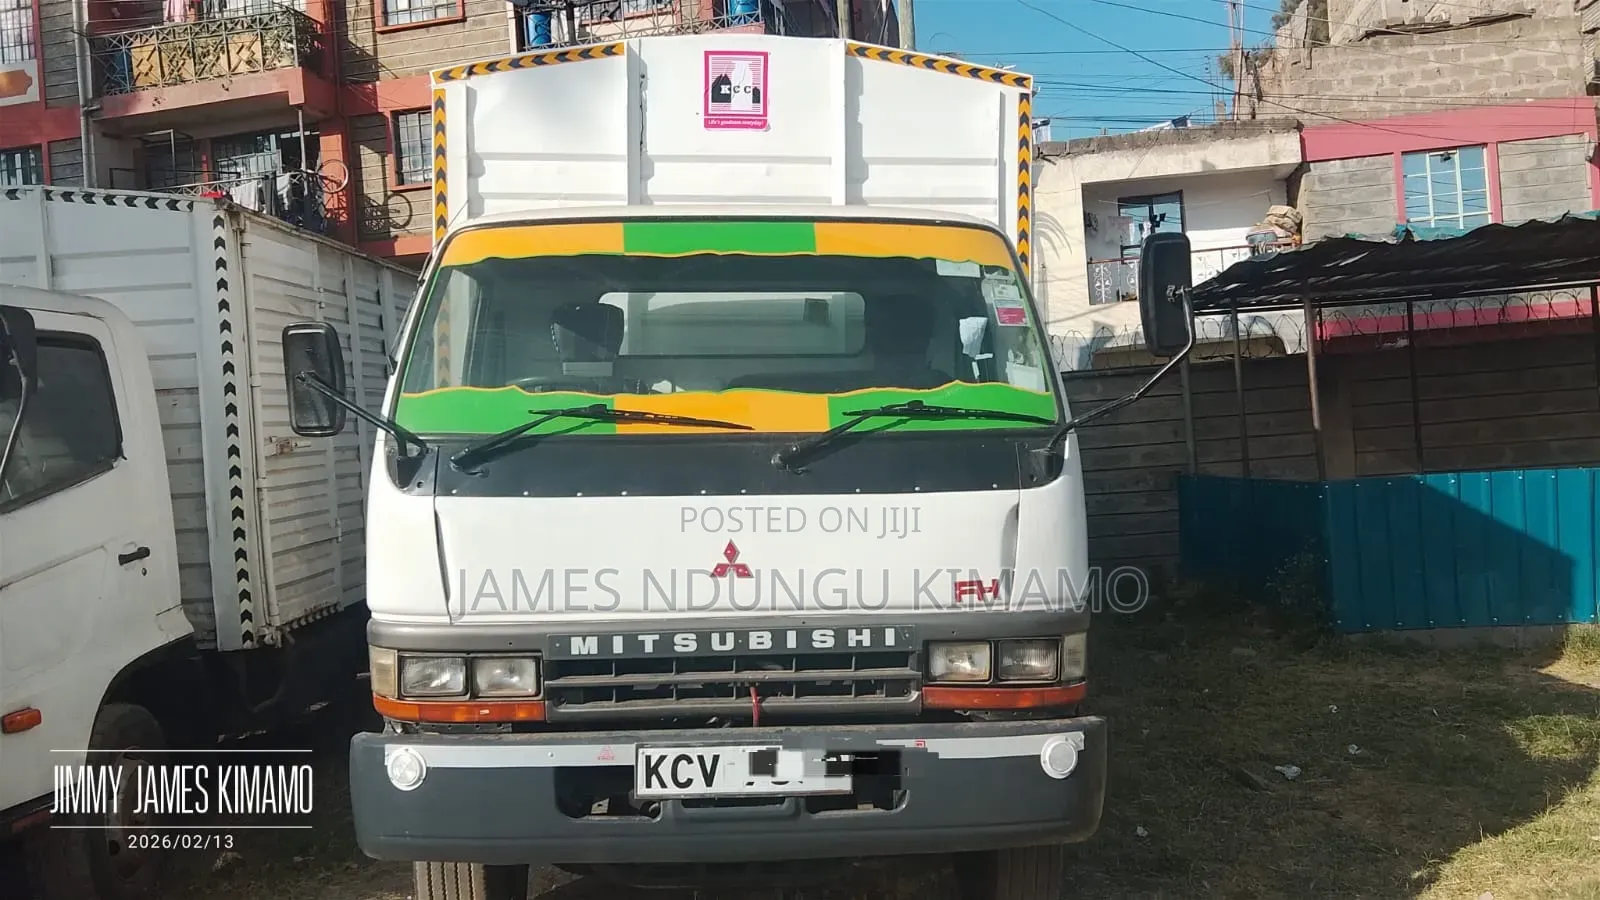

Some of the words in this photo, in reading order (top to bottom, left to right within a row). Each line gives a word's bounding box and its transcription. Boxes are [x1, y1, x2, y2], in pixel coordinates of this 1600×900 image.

[719, 84, 752, 94] KCC
[954, 578, 1000, 603] FH
[570, 628, 895, 656] MITSUBISHI
[644, 753, 720, 790] KCV
